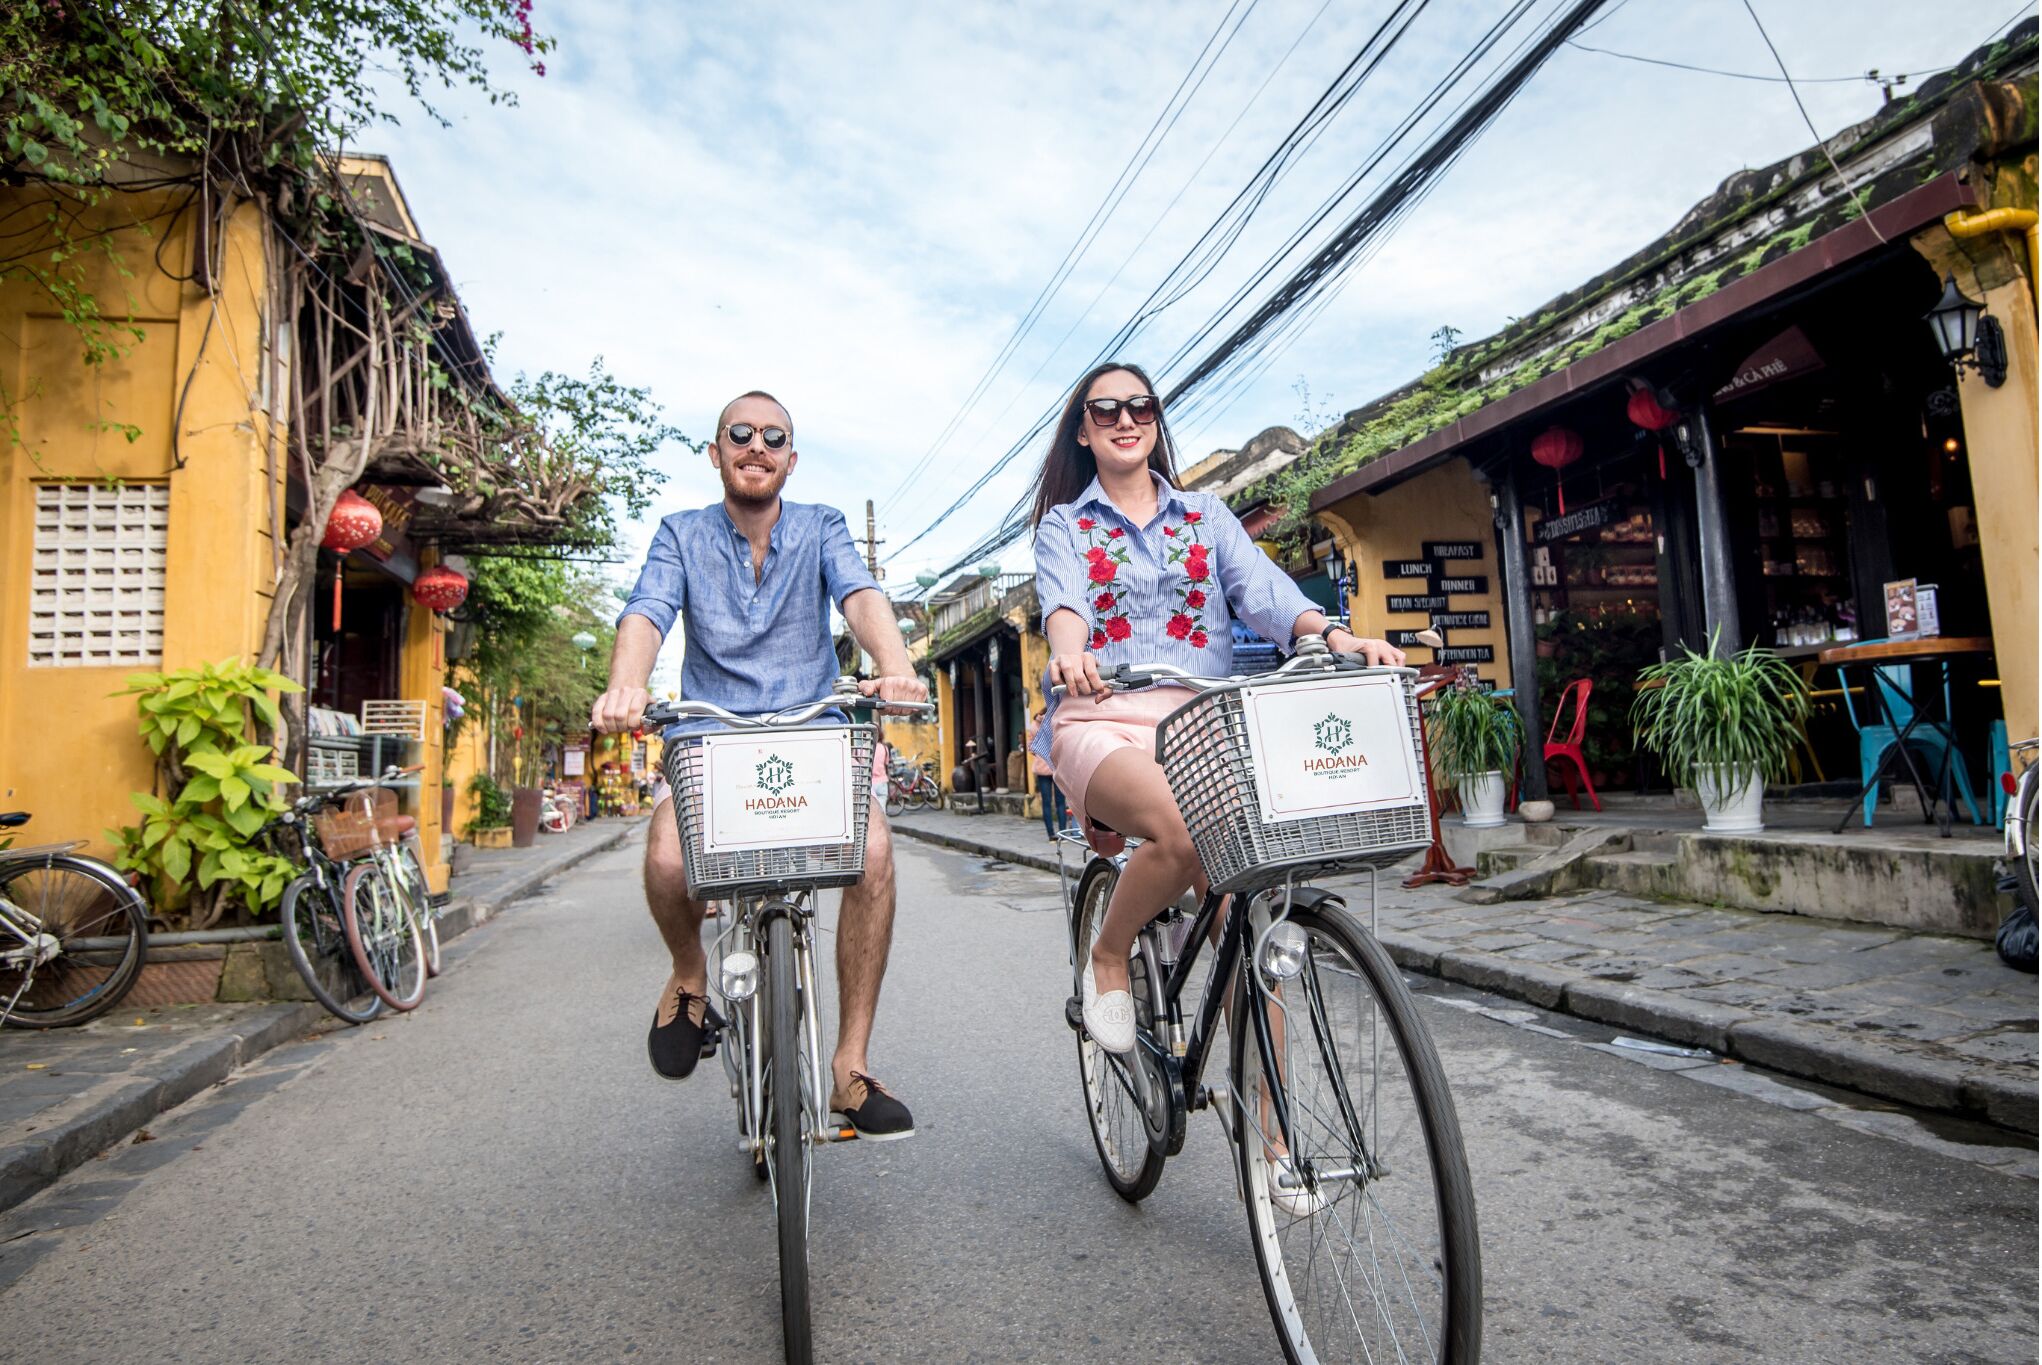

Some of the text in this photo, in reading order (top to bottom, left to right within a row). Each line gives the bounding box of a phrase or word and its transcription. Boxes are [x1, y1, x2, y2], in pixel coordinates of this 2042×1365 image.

[1400, 563, 1432, 575] LUNCH
[1440, 579, 1475, 591] DINNER
[1304, 754, 1368, 772] HADANA
[745, 795, 808, 811] HADANA
